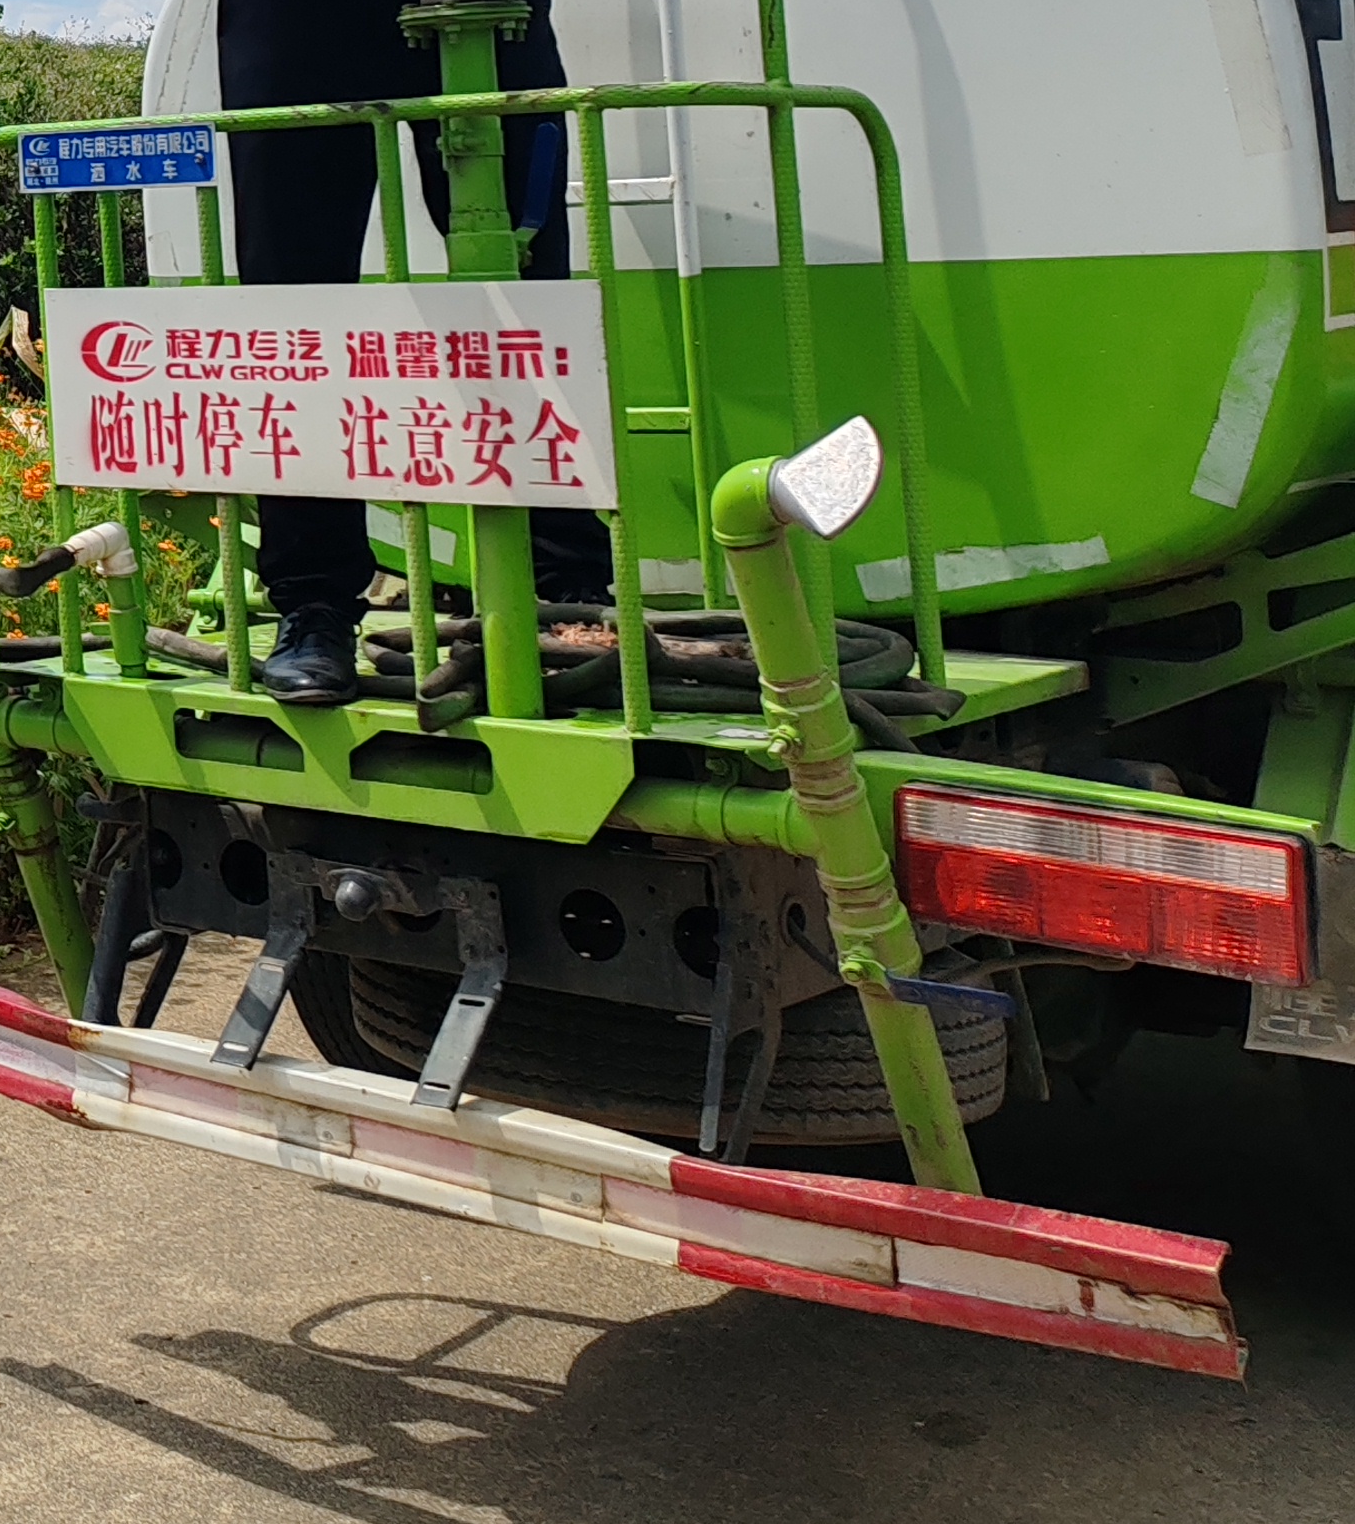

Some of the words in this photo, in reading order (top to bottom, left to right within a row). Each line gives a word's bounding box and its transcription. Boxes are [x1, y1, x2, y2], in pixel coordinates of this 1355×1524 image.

[165, 328, 324, 361] 程力专汽
[164, 362, 225, 380] CLW
[230, 365, 330, 382] GROUP
[90, 390, 302, 479] 随时停车
[339, 394, 585, 488] 注意安全
